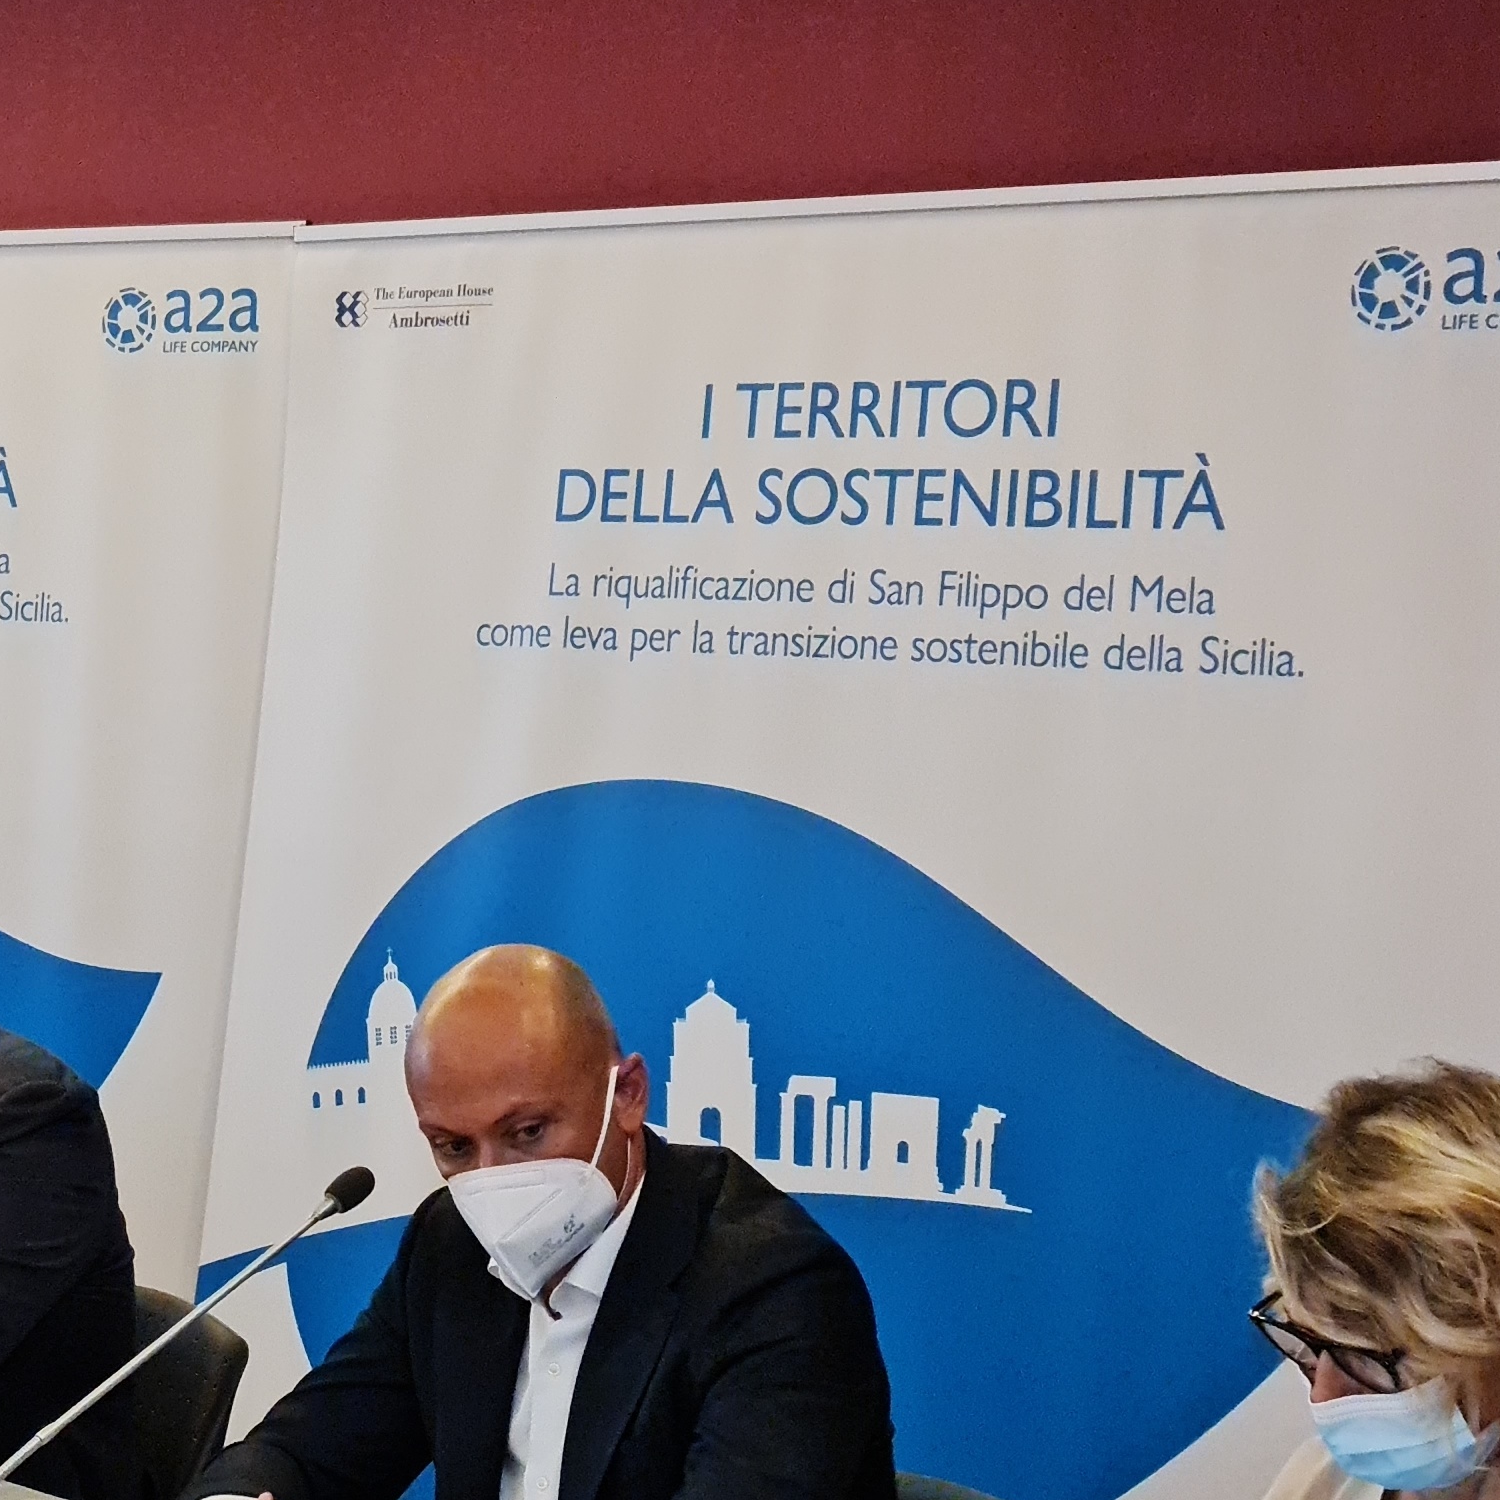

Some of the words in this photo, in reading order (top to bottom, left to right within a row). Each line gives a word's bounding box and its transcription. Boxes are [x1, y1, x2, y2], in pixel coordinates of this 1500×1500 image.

[163, 287, 259, 334] a2a
[373, 287, 394, 301] The
[398, 286, 453, 302] European
[457, 284, 494, 298] House
[388, 310, 470, 329] Ambrosetti
[1441, 313, 1479, 331] LIFE
[162, 341, 188, 353] LIFE
[190, 340, 259, 353] COMPANY
[701, 383, 714, 440] I
[735, 377, 1061, 439] TERRITORI
[554, 467, 734, 525] DELLA
[754, 451, 1226, 533] SOSTENIBILITÀ
[548, 562, 581, 600] La
[592, 564, 815, 612] riqualificazione
[827, 567, 856, 605] di
[867, 568, 924, 607] San
[938, 570, 1049, 621] Filippo
[1063, 573, 1116, 613] del
[1130, 574, 1217, 616] Mela
[476, 623, 552, 652] come
[562, 614, 619, 652] leva
[629, 628, 682, 663] per
[692, 619, 715, 655] la
[726, 624, 899, 664] transizione
[910, 630, 1090, 670] sostenibile
[1103, 632, 1185, 674] della
[1199, 635, 1305, 678] Sicilia.
